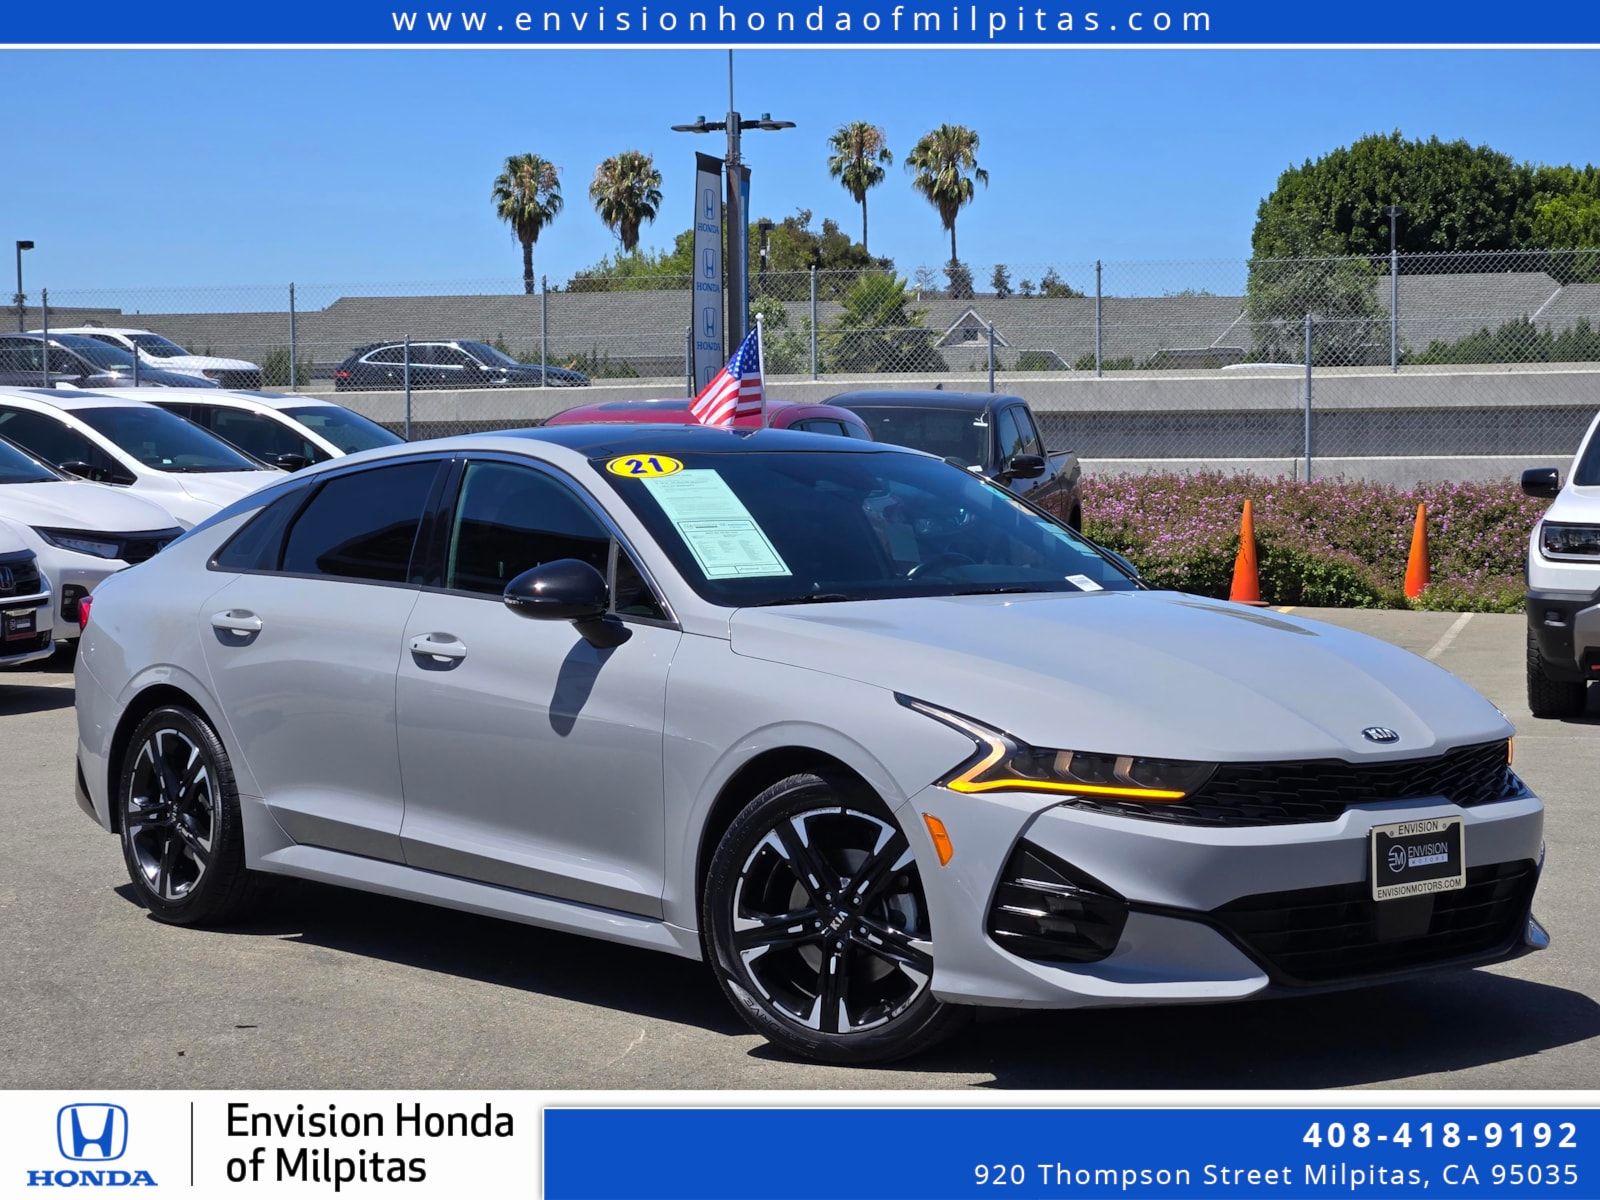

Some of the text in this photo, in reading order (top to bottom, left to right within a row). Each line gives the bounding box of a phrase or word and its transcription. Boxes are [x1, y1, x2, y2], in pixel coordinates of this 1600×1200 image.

[697, 223, 720, 235] HONDA
[696, 281, 720, 293] HONDA
[696, 341, 721, 352] HONDA
[625, 457, 664, 474] 21
[1365, 727, 1397, 740] KIA
[1398, 821, 1439, 835] ENVISION
[1407, 842, 1448, 858] ENVISION
[1377, 879, 1462, 899] ENVISIONMOTORS.COM
[829, 911, 849, 931] KIA
